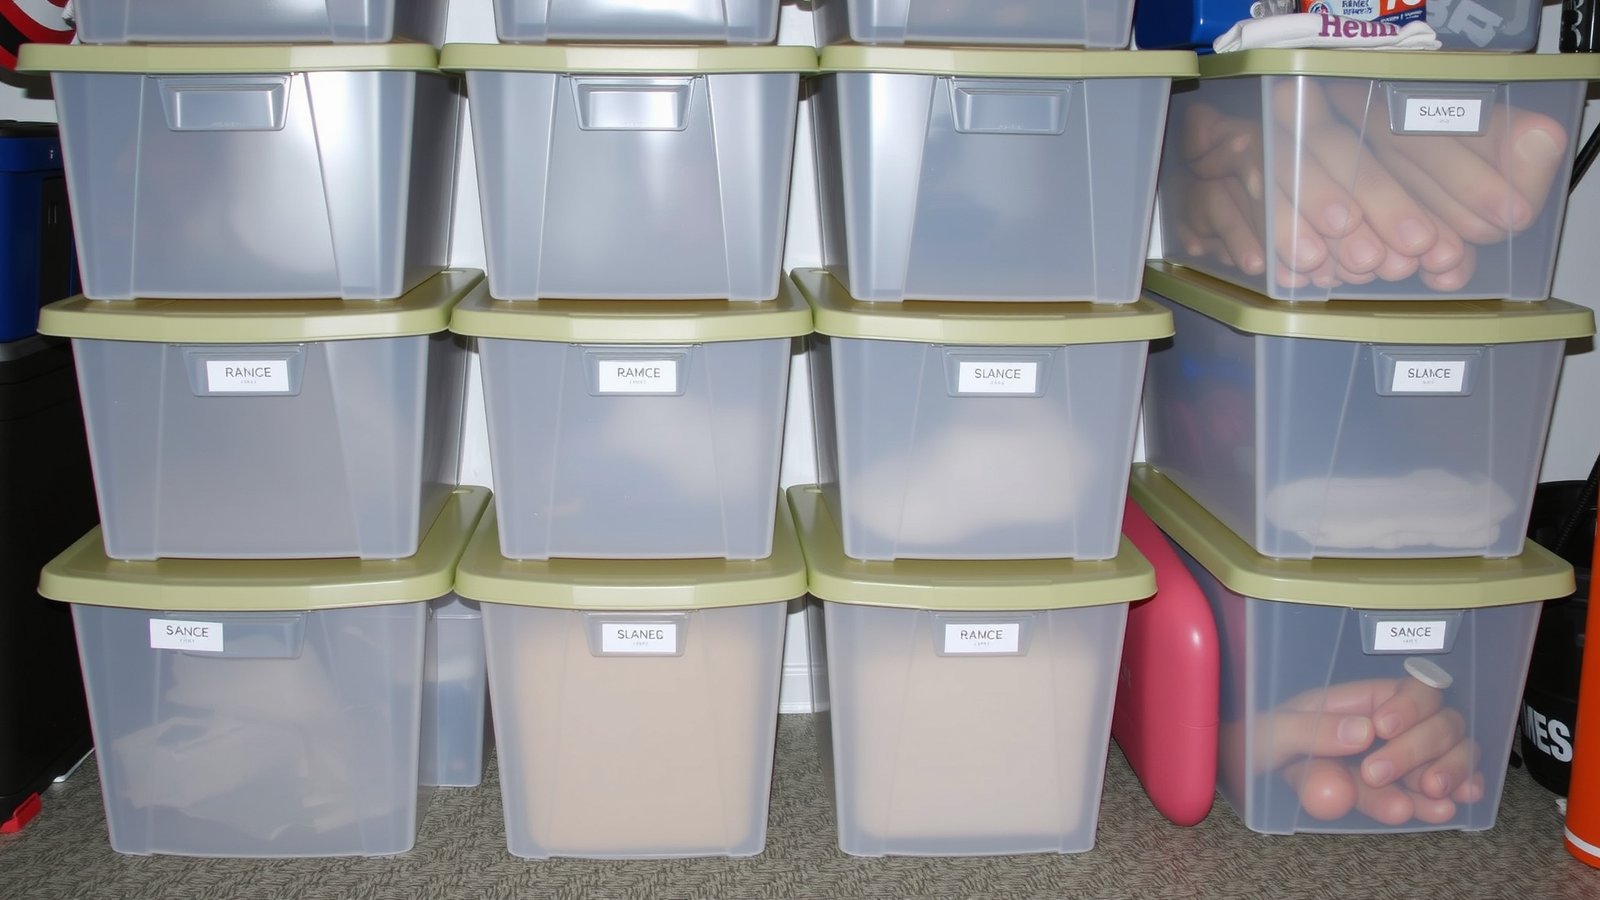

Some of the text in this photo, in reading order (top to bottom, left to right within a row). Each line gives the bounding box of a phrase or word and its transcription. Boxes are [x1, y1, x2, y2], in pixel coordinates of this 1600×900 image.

[974, 367, 1021, 379] SLANCE
[166, 624, 209, 638] SANCE
[1390, 626, 1431, 638] SANCE
